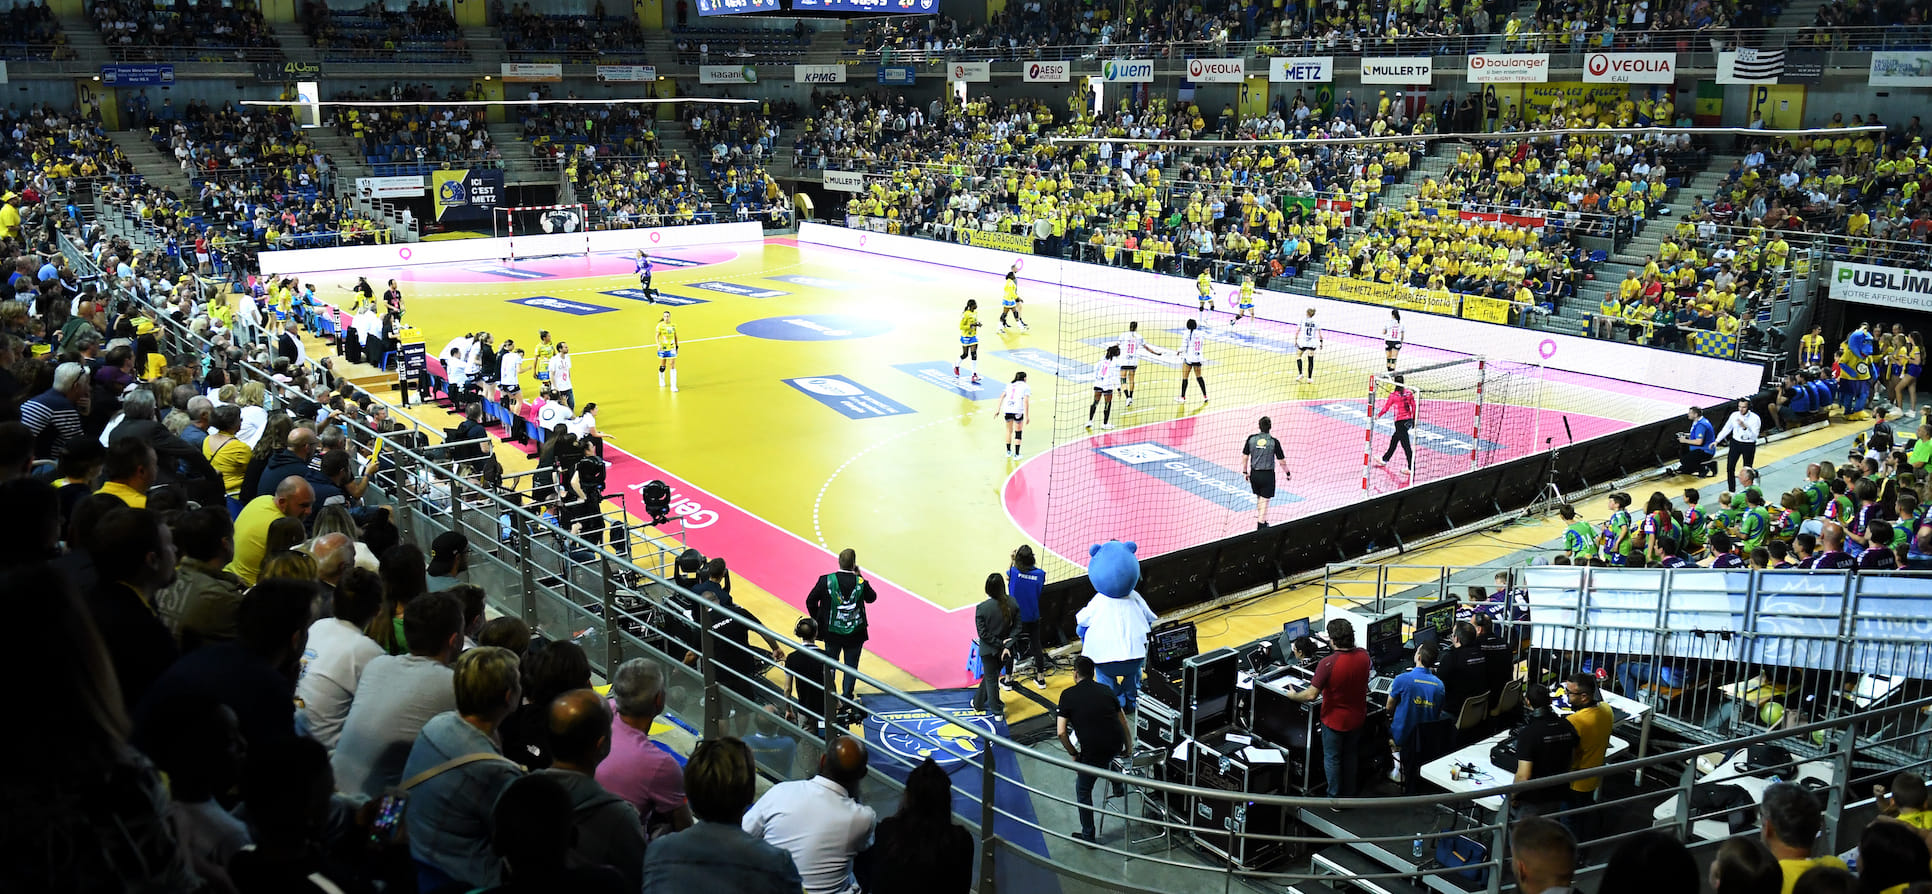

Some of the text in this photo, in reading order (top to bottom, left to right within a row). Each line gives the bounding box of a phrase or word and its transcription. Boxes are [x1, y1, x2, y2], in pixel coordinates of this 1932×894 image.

[1204, 64, 1241, 74] VEOLIA
[1487, 58, 1546, 69] boulanger
[1612, 59, 1671, 73] VEOLIA
[1119, 64, 1151, 77] uem
[1286, 66, 1322, 80] METZ
[1372, 66, 1430, 76] MULLER TP
[804, 72, 837, 82] KPMG
[81, 84, 90, 104] D
[1241, 82, 1249, 104] R
[1757, 86, 1768, 110] P
[471, 178, 482, 186] ICI
[829, 176, 853, 185] MULLER
[471, 186, 494, 195] C'EST
[471, 195, 496, 203] METZ
[972, 230, 991, 242] ALLEZ
[1842, 289, 1870, 300] VOTRE
[1871, 292, 1920, 305] AFFICHEUR
